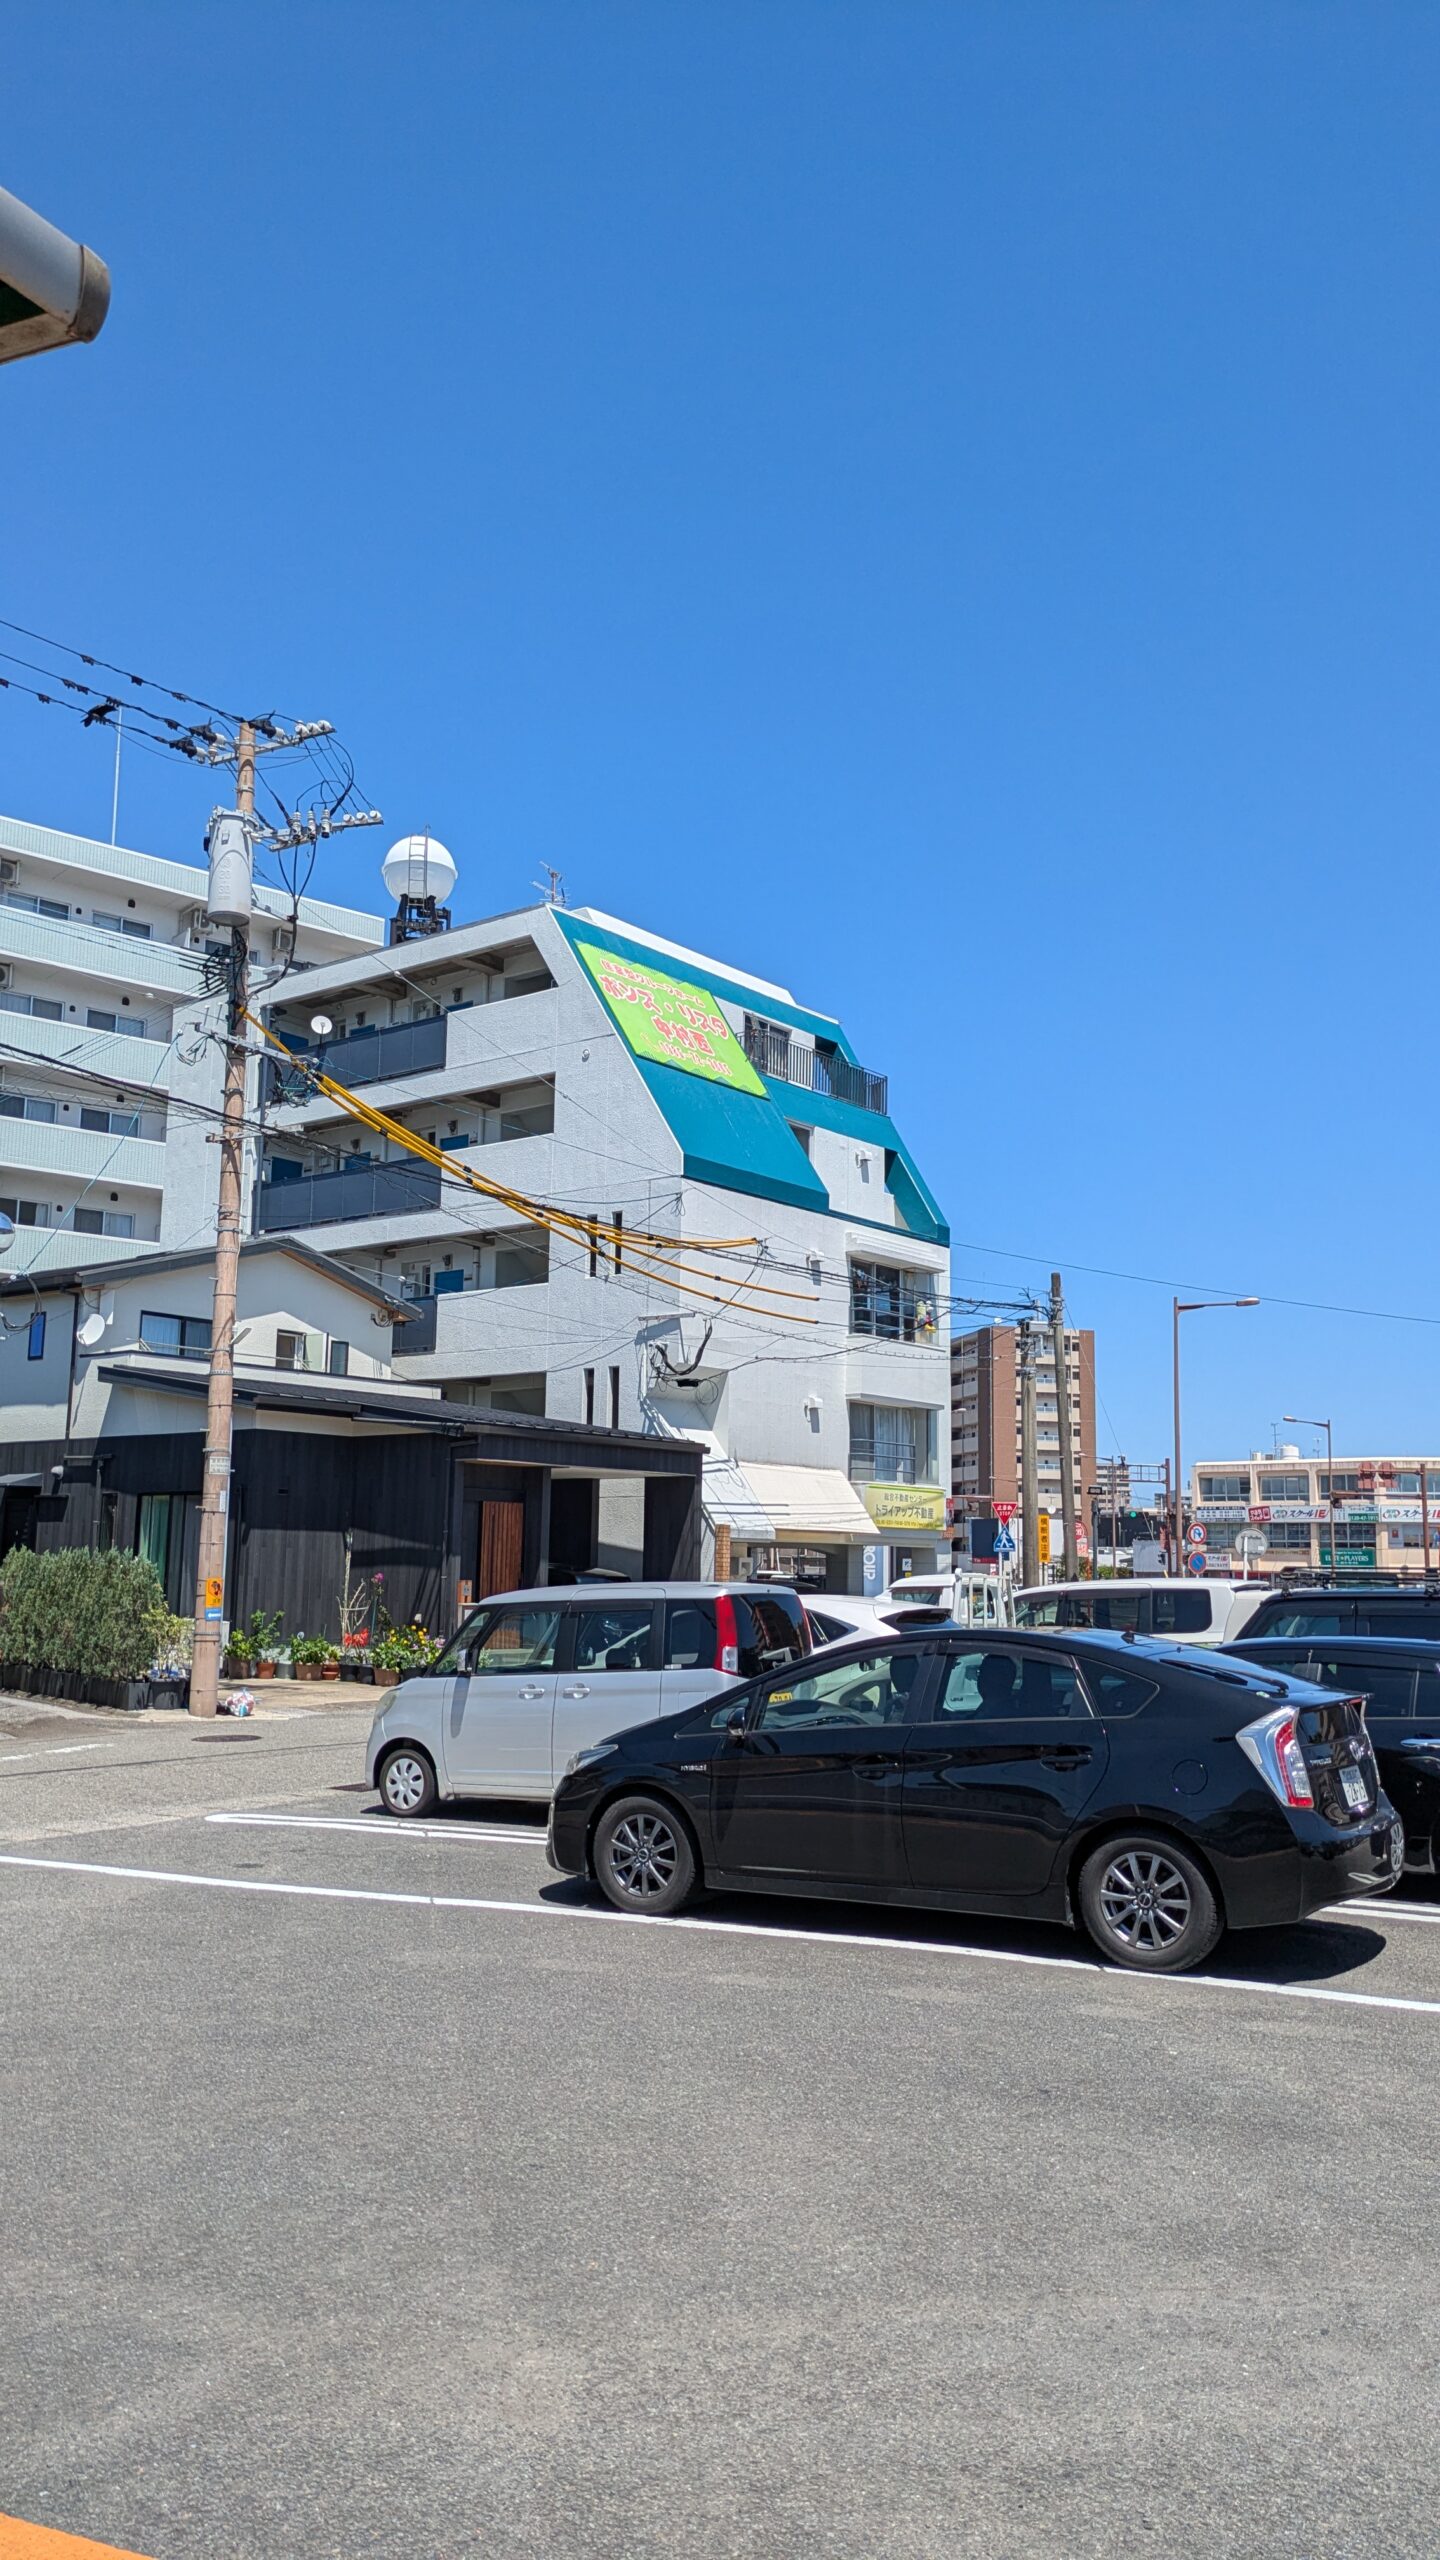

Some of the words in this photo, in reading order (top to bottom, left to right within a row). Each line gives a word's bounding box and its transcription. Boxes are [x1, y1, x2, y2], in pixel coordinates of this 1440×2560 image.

[876, 1504, 934, 1519] トライアップ不動産
